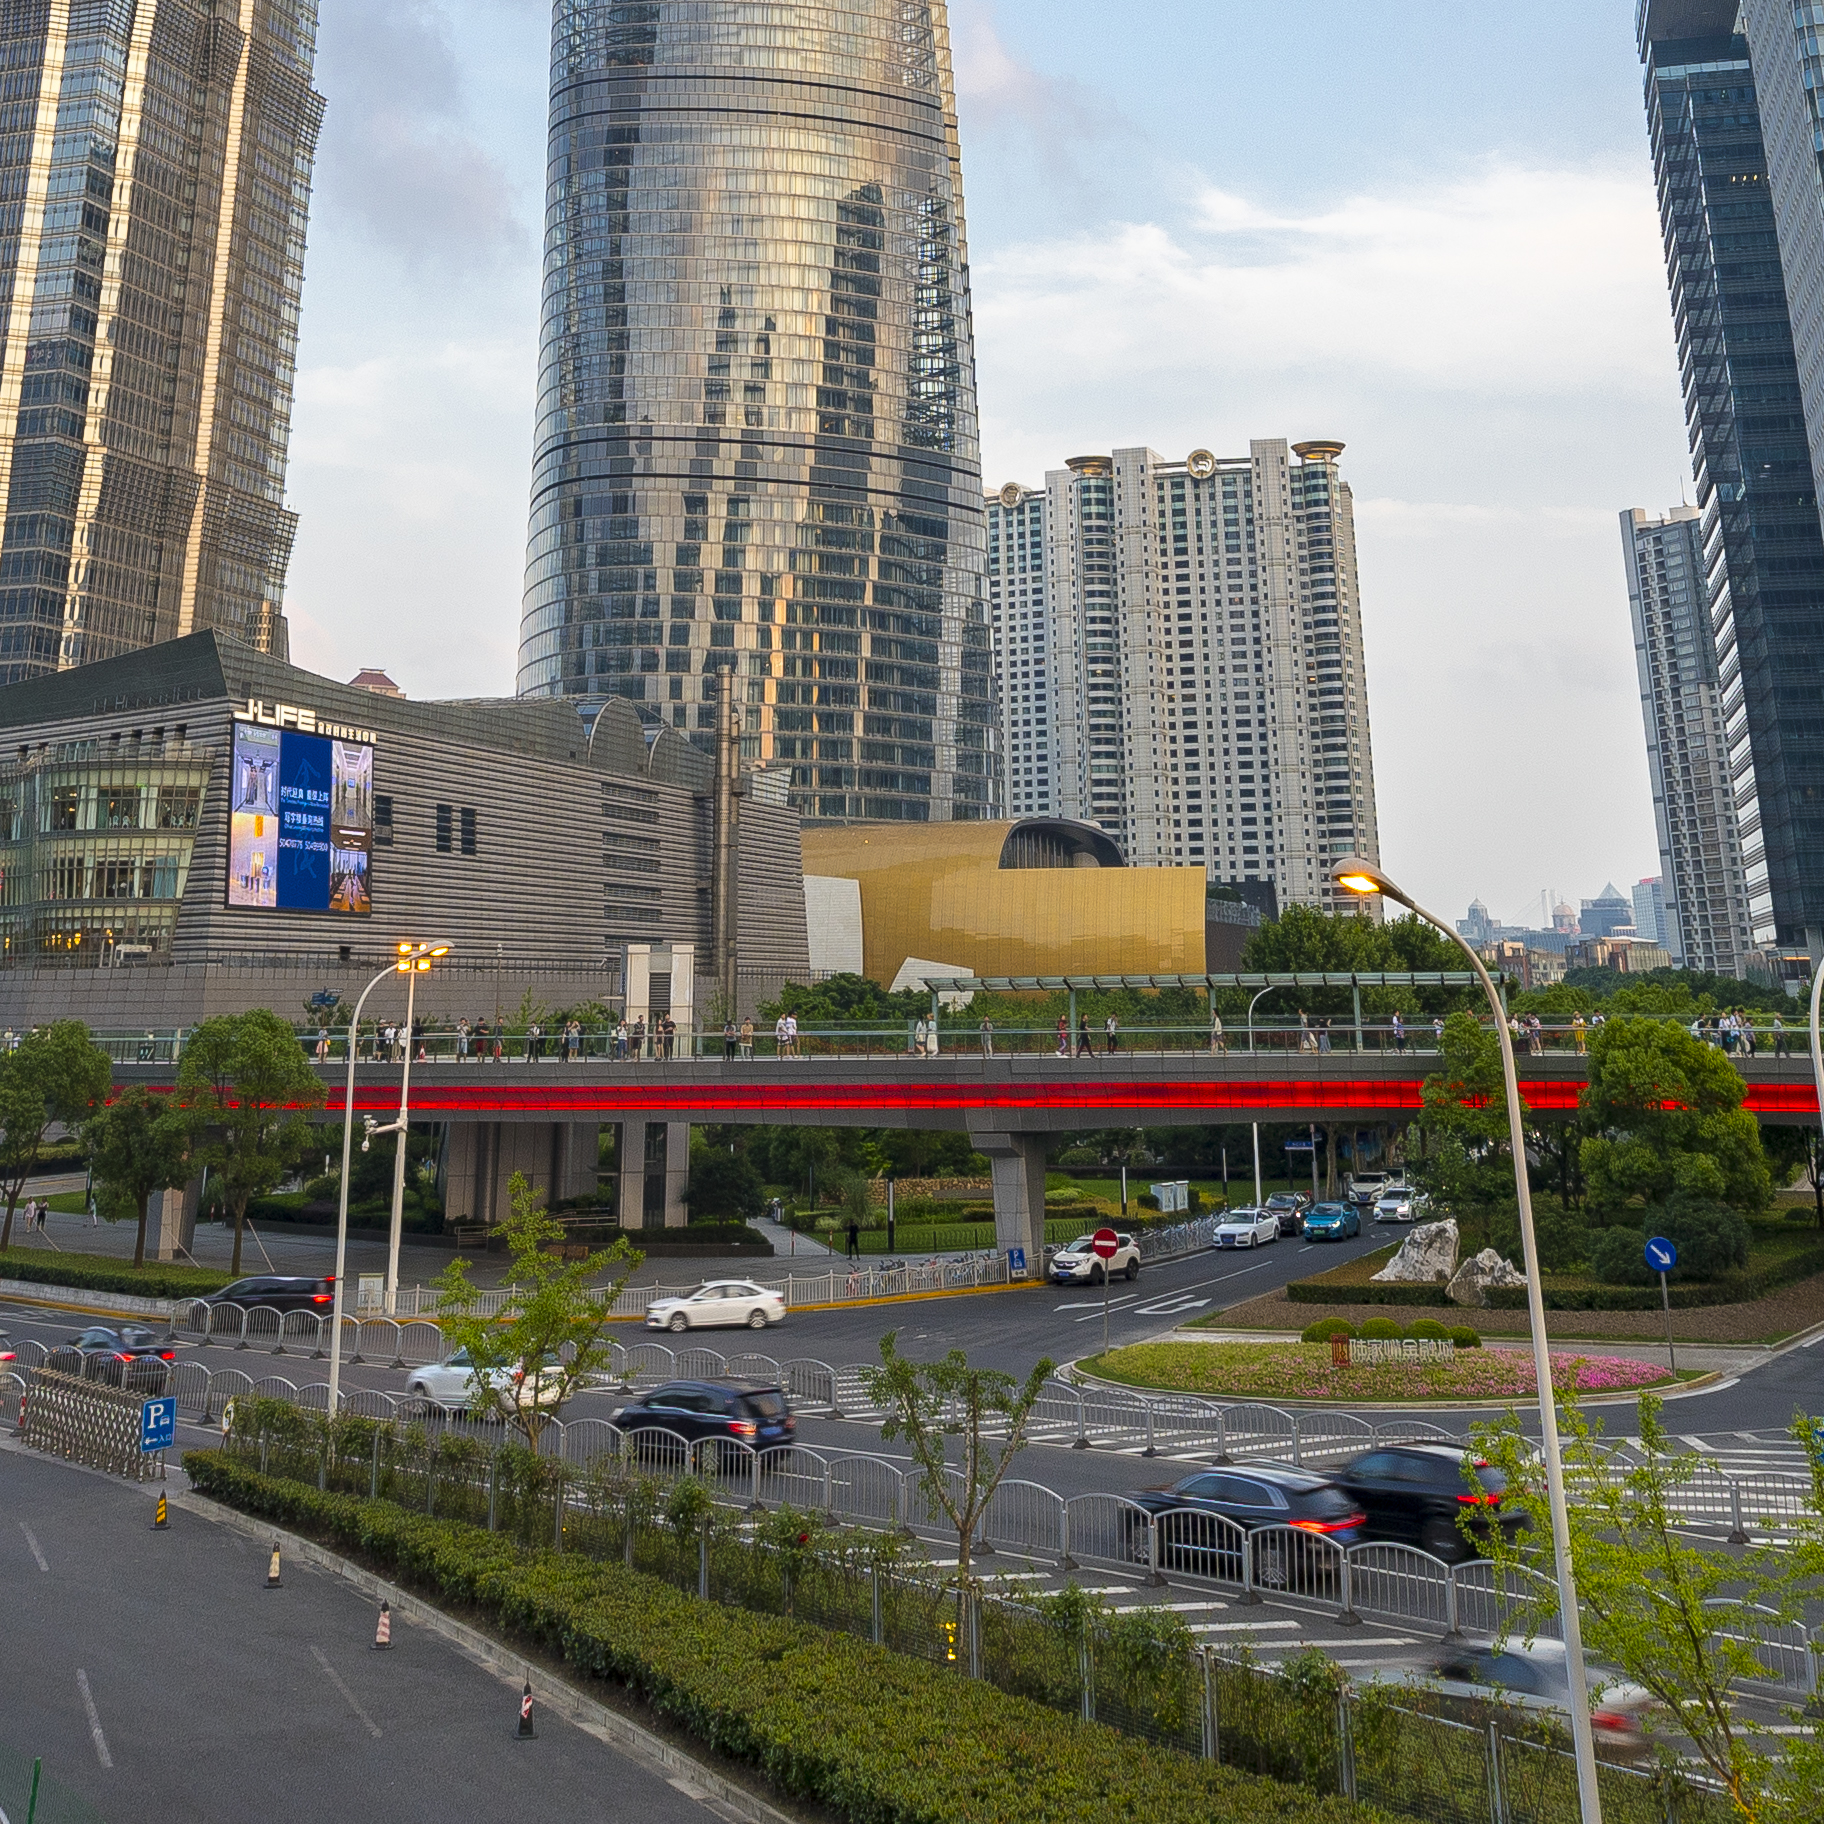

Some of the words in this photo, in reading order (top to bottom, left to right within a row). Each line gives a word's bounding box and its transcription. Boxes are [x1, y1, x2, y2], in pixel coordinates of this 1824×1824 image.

[1349, 1338, 1455, 1363] 陆家嘴金融城
[147, 1404, 164, 1429] P
[158, 1433, 172, 1443] 入口
